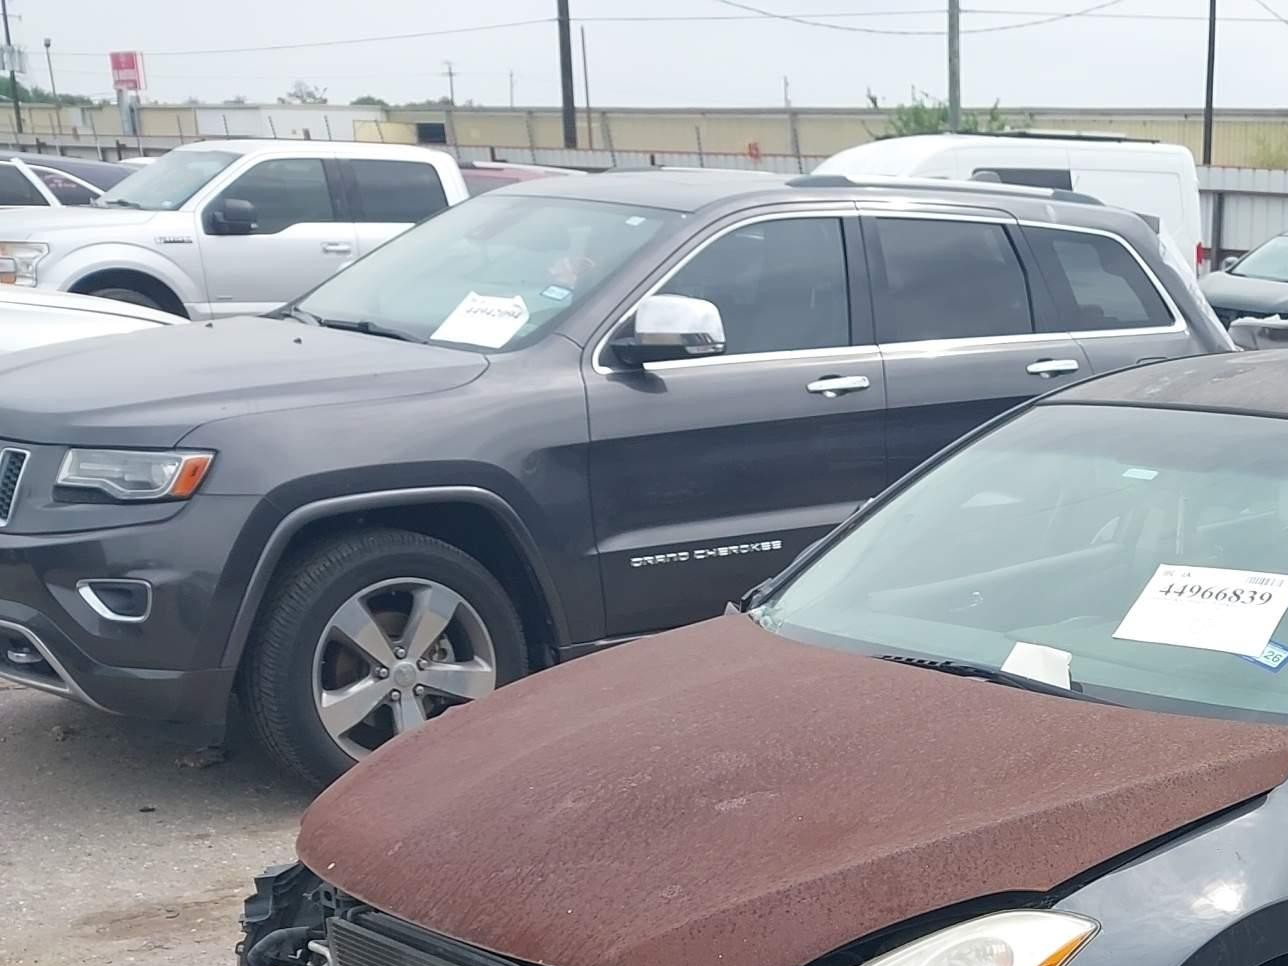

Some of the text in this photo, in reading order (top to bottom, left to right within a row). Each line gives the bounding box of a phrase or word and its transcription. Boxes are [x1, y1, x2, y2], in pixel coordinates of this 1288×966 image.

[630, 540, 783, 568] GRAND CHEROKEE
[1159, 583, 1273, 606] 44966839
